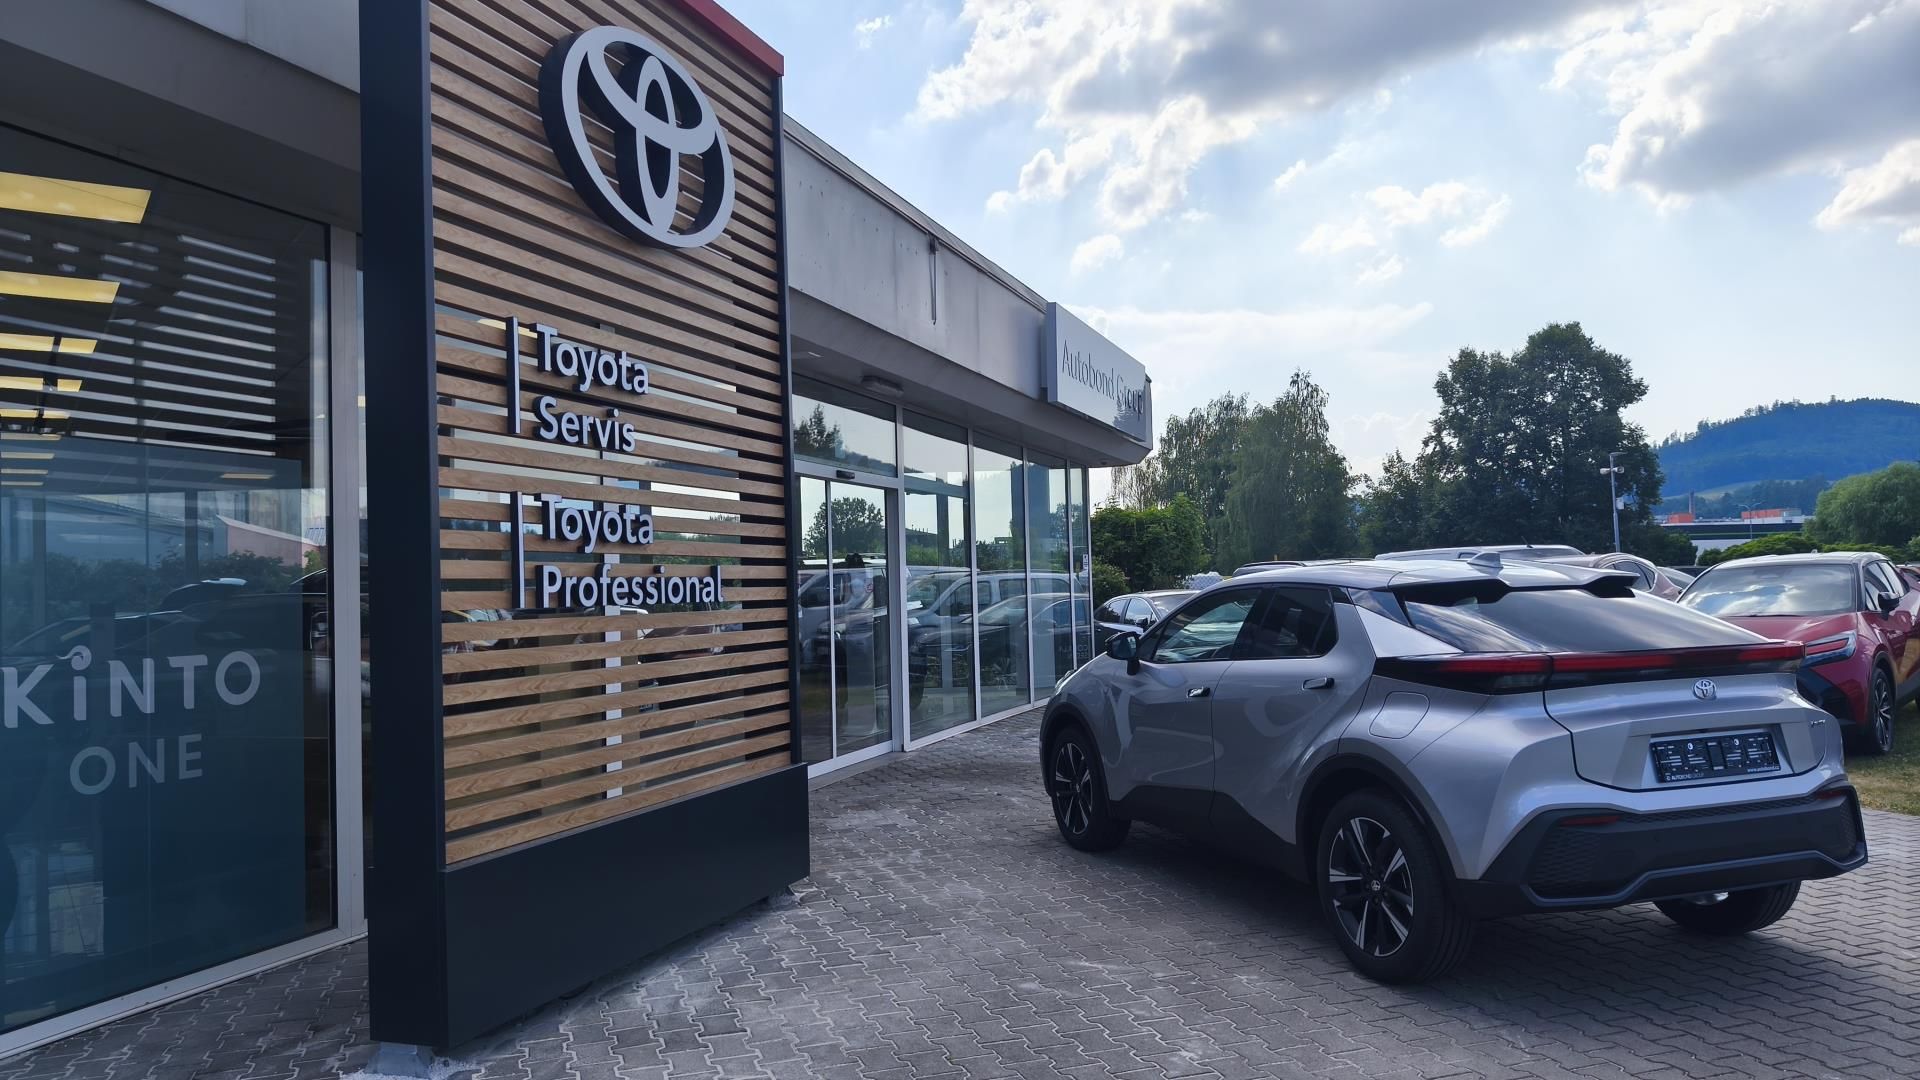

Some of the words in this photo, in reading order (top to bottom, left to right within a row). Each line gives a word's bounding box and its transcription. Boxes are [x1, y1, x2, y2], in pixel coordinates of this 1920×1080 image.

[535, 322, 650, 395] Toyota
[1062, 338, 1115, 401] Autobond
[537, 395, 637, 452] Servis
[538, 492, 655, 554] Toyota
[541, 563, 725, 609] Professional
[69, 733, 204, 796] ONE
